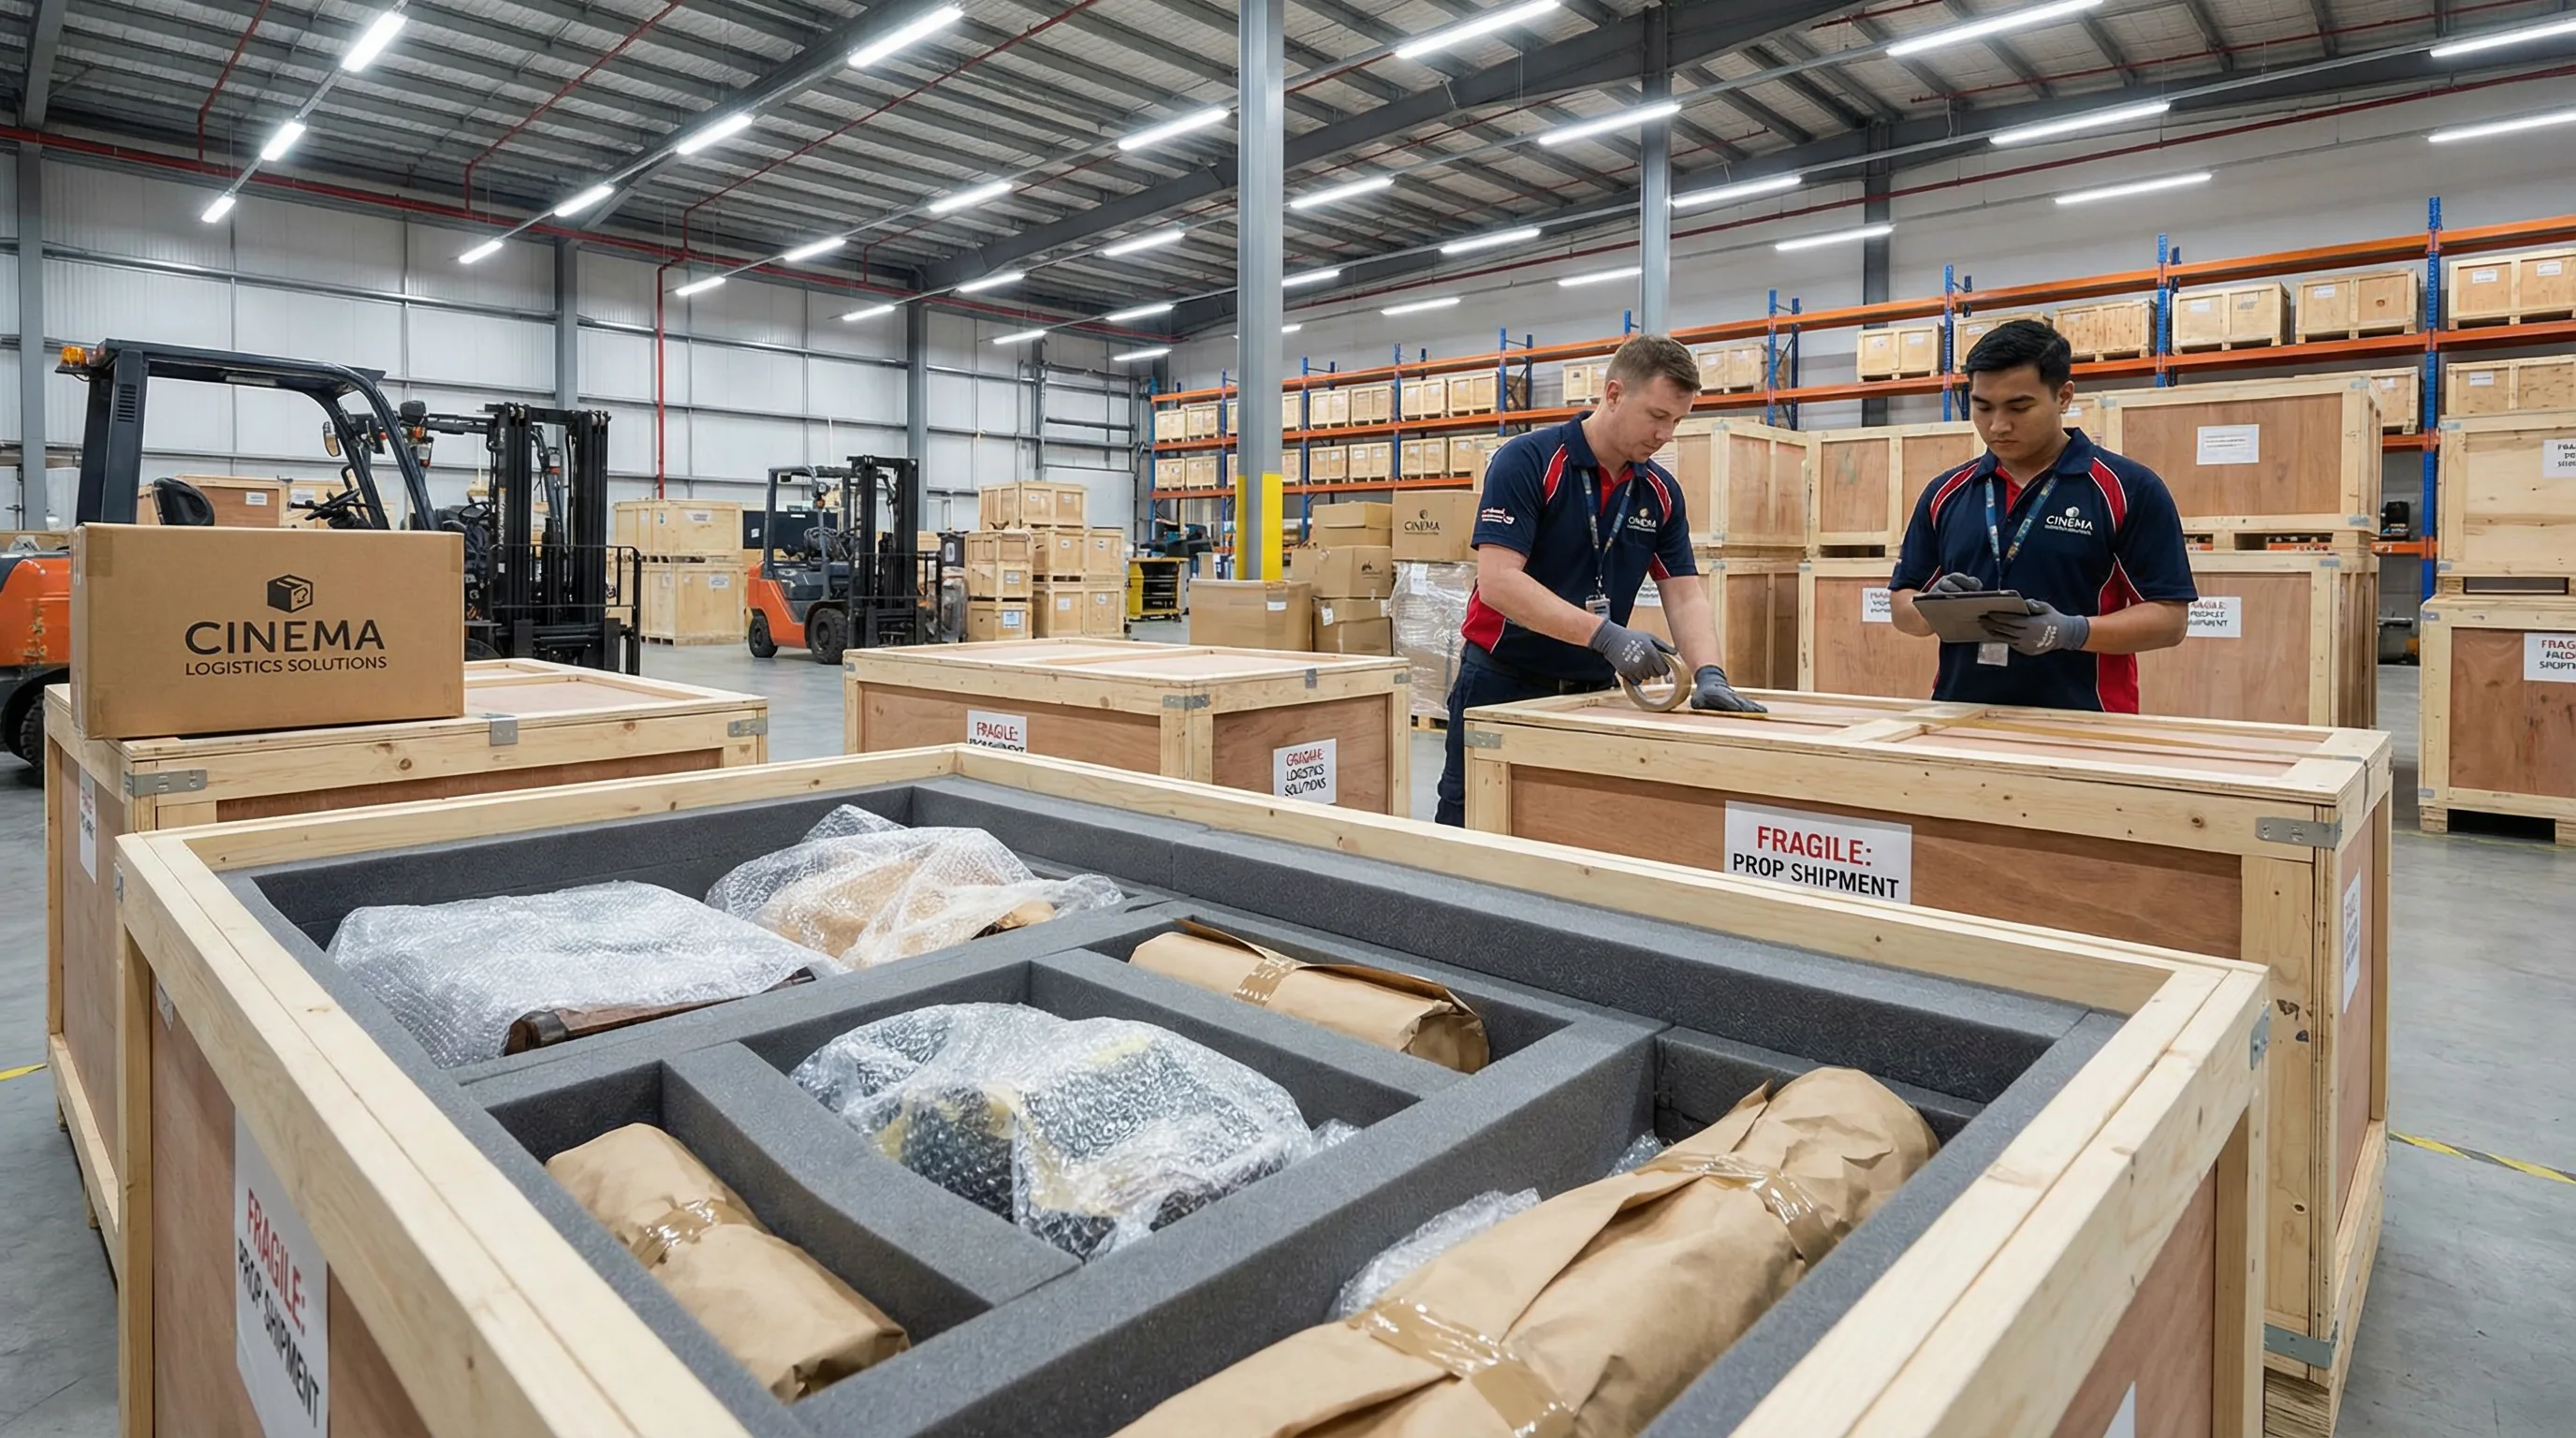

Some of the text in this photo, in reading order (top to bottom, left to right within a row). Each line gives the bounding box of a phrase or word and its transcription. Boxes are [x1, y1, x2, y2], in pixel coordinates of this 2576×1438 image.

[184, 619, 386, 655] CINEMA
[185, 656, 388, 676] LOGISTICS SOLUTIONS
[1756, 825, 1872, 867] FRAGILE:
[1733, 853, 1899, 899] PROP SHIPMENT
[247, 1186, 306, 1338] FRAGILE:
[263, 1288, 320, 1429] SHIPMENT
